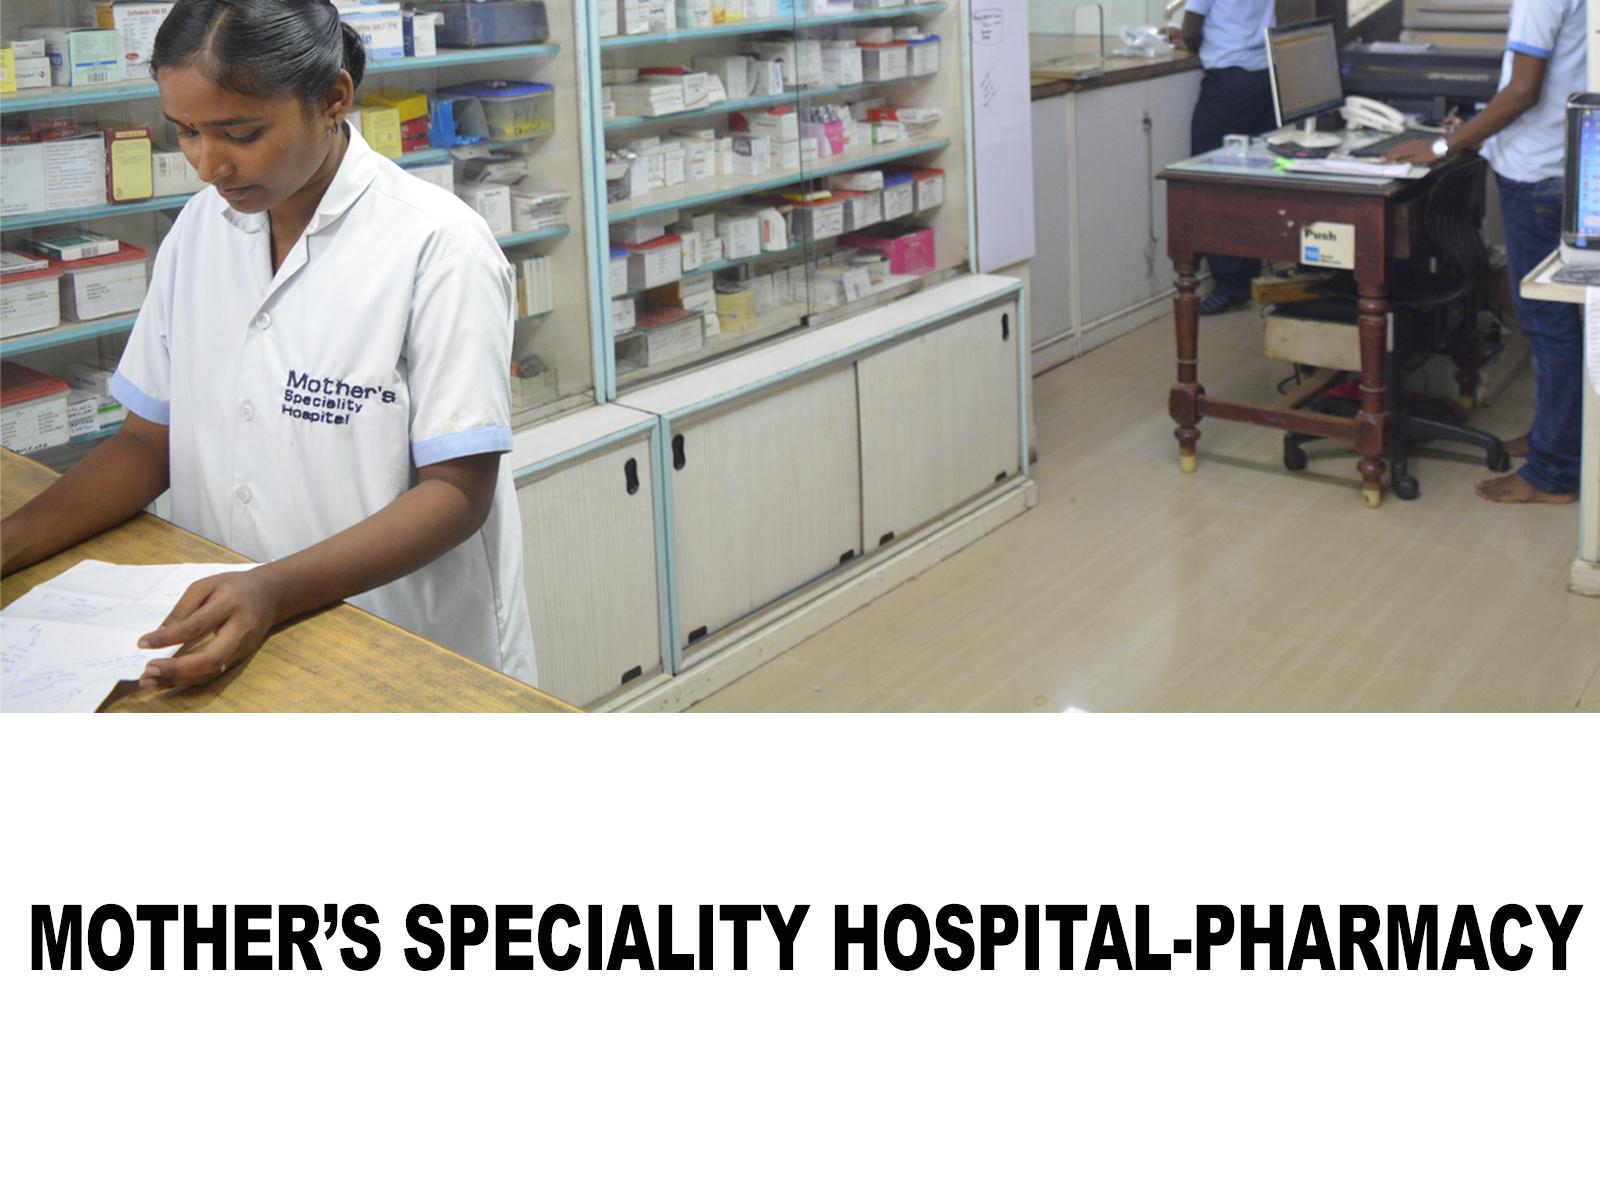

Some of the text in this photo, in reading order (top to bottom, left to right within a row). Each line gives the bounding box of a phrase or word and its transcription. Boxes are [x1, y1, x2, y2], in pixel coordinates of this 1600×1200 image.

[1303, 228, 1337, 242] Push
[286, 369, 396, 403] Mother's
[284, 389, 363, 413] Speciality
[281, 404, 350, 425] Hospital
